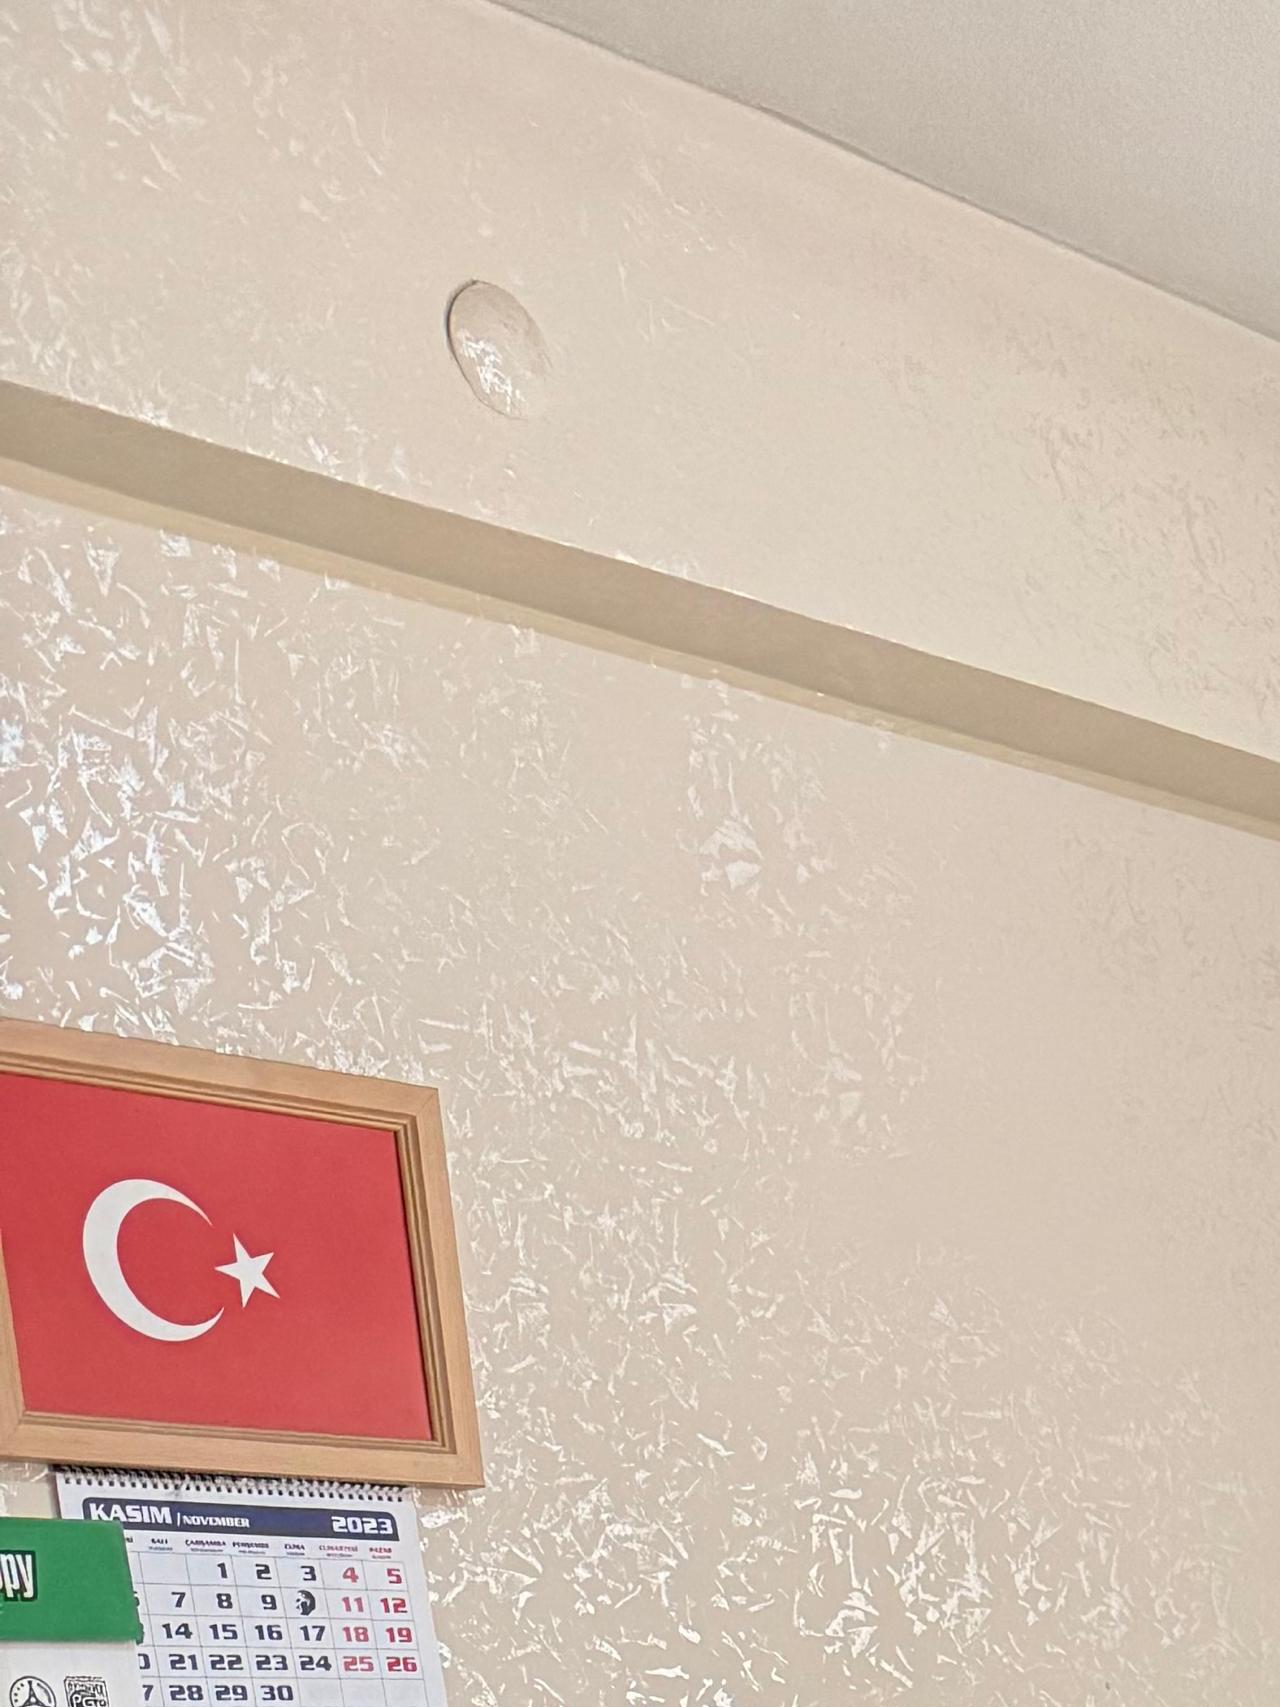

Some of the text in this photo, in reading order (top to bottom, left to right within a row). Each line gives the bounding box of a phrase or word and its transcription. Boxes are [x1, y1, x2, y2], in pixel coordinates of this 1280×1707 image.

[87, 1502, 173, 1524] KASIM
[331, 1515, 394, 1535] 2023
[217, 1561, 403, 1585] 1 2 3 4 5
[171, 1591, 408, 1614] 7 8 9 11 12
[162, 1622, 413, 1644] 14 15 16 17 18 19
[168, 1653, 199, 1671] 21
[208, 1653, 245, 1671] 22
[254, 1655, 289, 1672] 23
[299, 1655, 332, 1672] 24
[342, 1656, 374, 1673] 25
[386, 1656, 418, 1673] 26
[168, 1683, 205, 1701] 28
[214, 1684, 248, 1701] 29
[260, 1684, 294, 1702] 30
